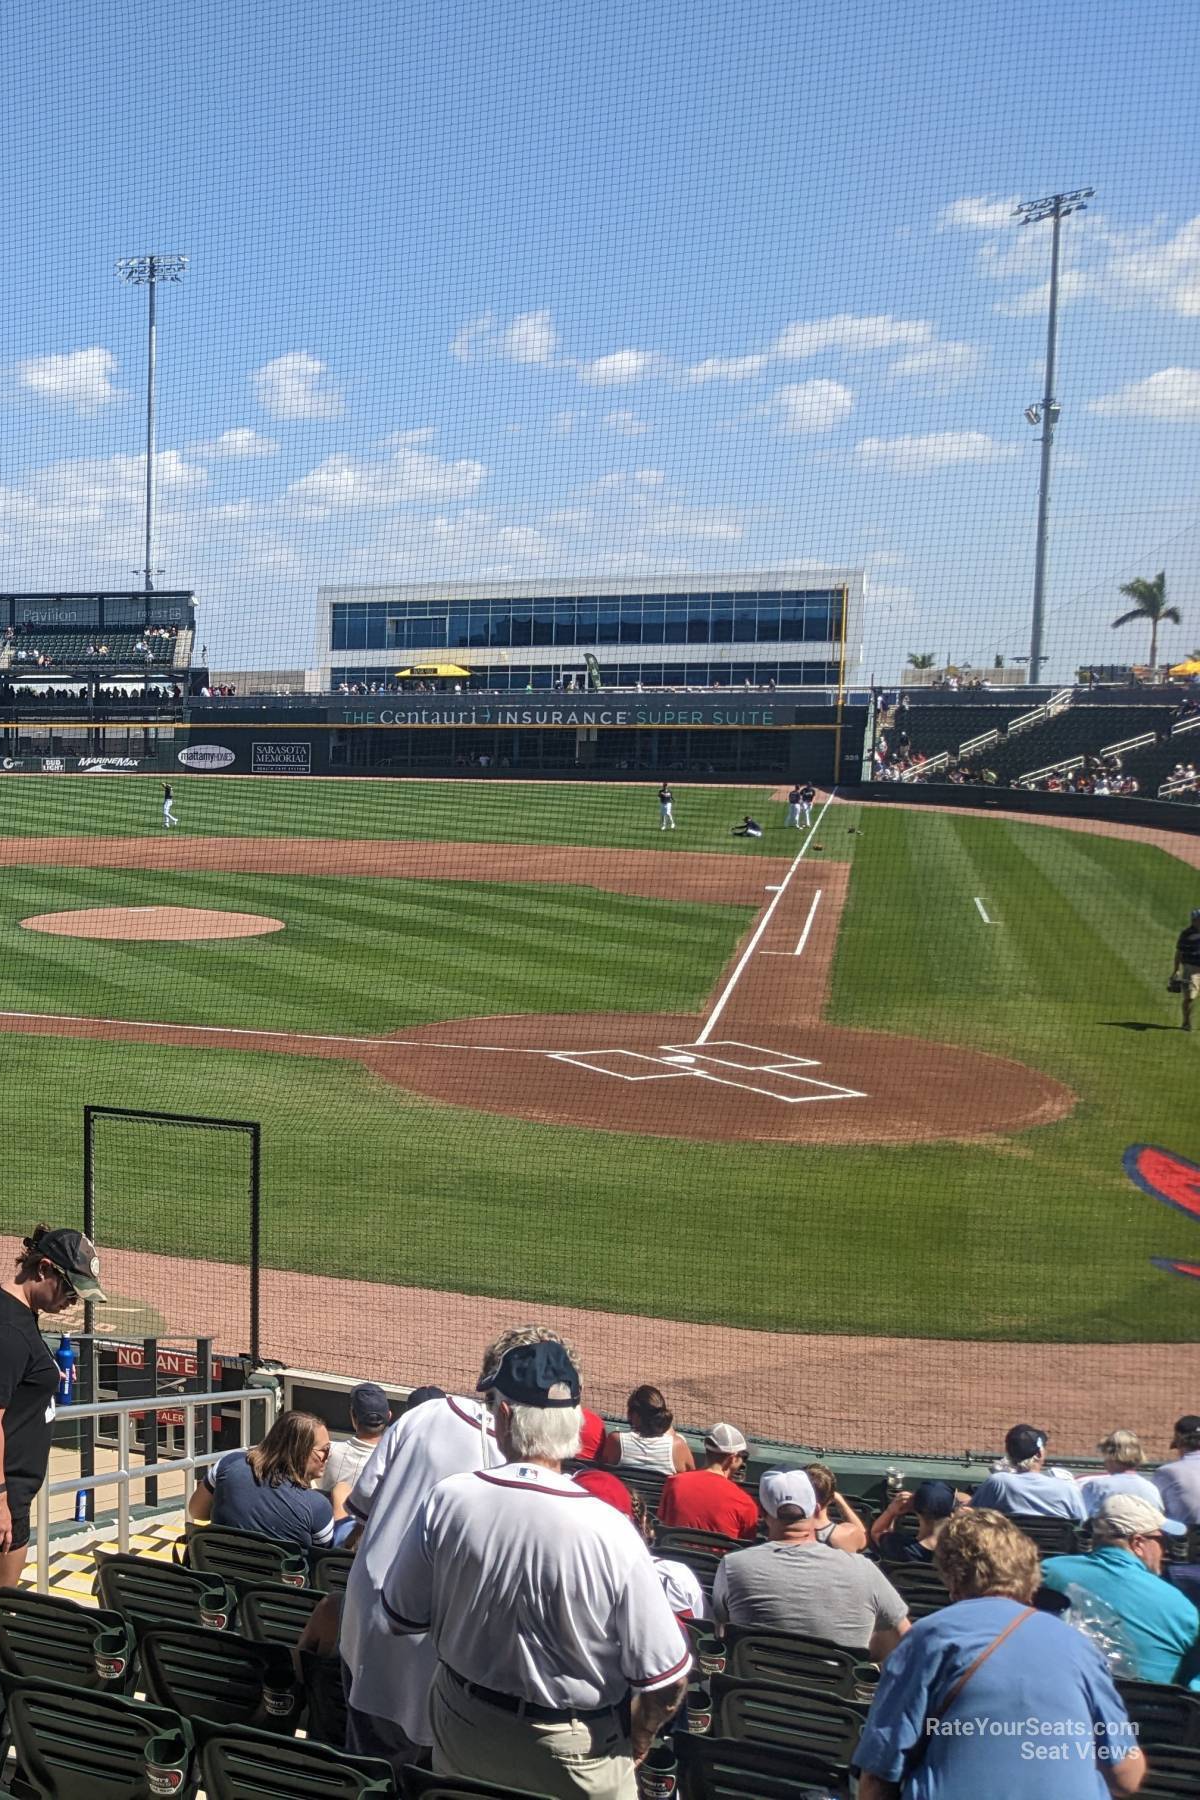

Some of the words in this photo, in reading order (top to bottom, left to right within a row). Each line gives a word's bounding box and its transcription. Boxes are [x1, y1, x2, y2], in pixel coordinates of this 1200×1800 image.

[23, 608, 77, 622] Pavilion
[343, 712, 377, 724] THE
[380, 706, 476, 724] Centauri
[497, 711, 629, 725] INSURANCE
[636, 711, 703, 725] SUPER
[712, 711, 774, 725] SUITE
[256, 745, 307, 754] SARASOTA
[256, 754, 307, 763] MEMORIAL
[118, 1348, 145, 1366] NO
[157, 1354, 179, 1372] AN
[184, 1358, 218, 1377] ET
[161, 1413, 185, 1422] ALER
